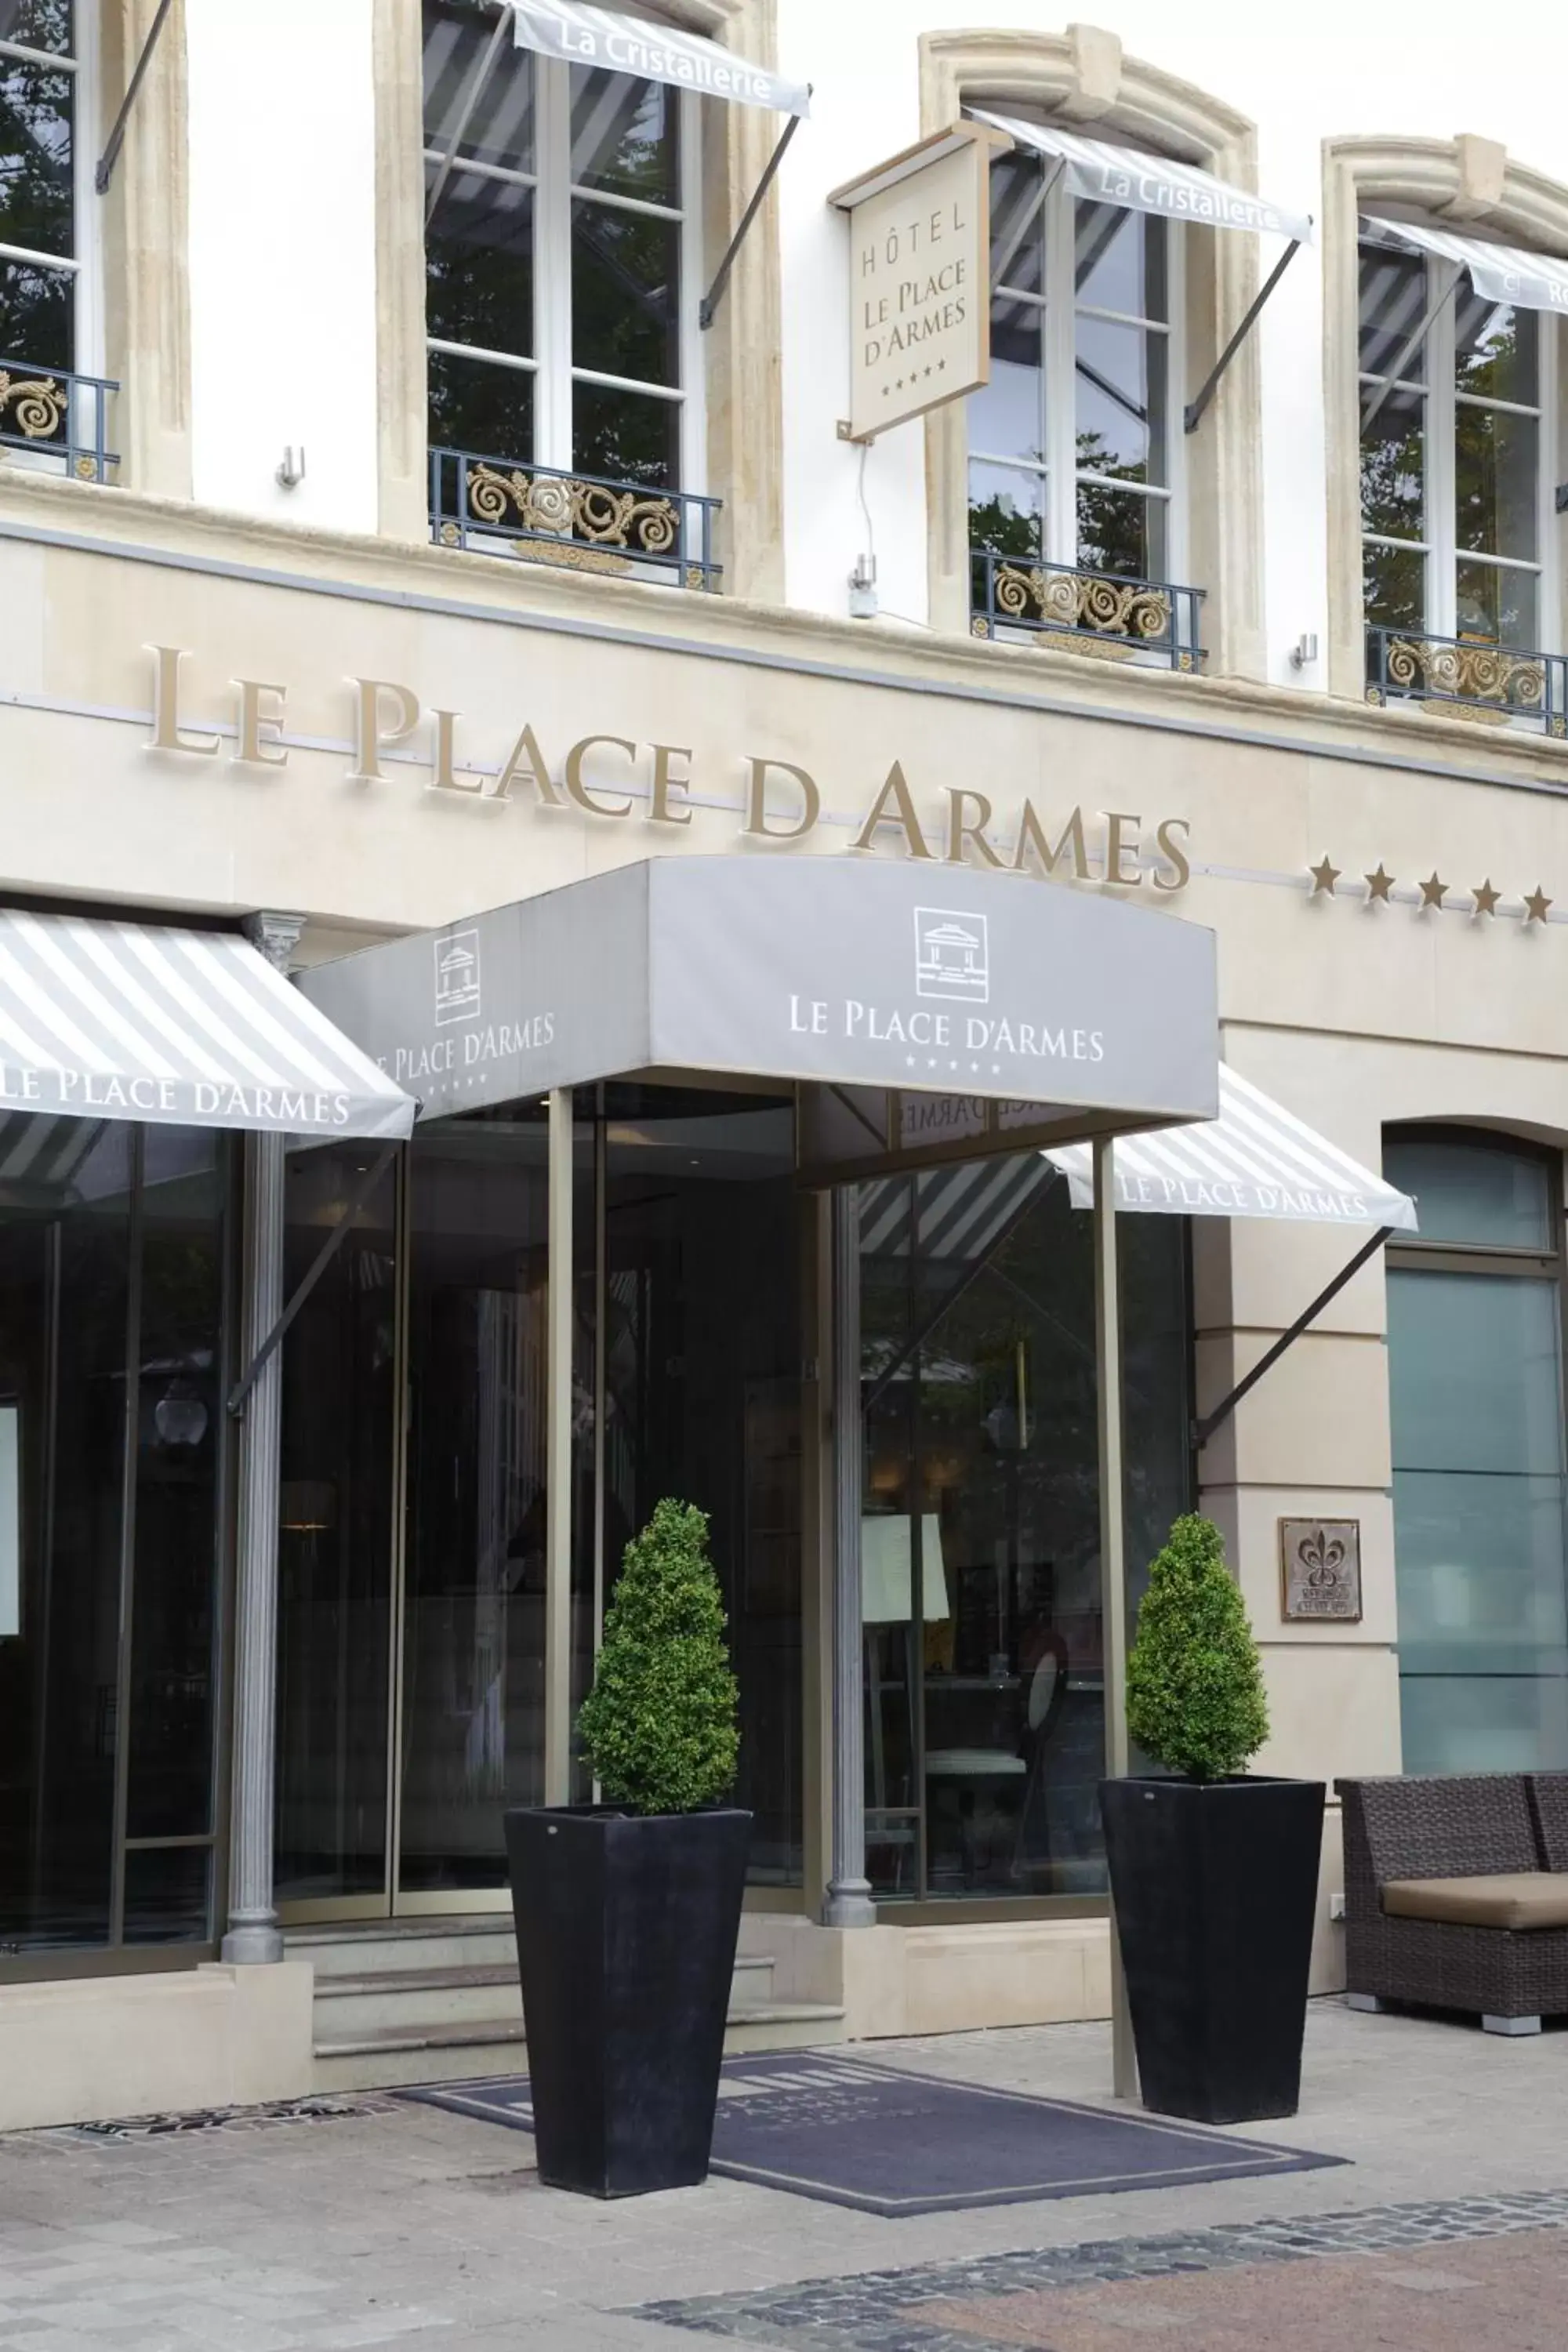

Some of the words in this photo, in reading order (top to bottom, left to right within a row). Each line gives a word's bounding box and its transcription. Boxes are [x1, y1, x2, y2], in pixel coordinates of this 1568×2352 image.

[560, 20, 596, 56] La
[605, 32, 771, 99] Cristallerie
[1101, 167, 1131, 198] La
[1139, 176, 1281, 229] Cristallerie
[862, 202, 966, 278] HÔTEL
[865, 301, 888, 330] LE
[898, 259, 966, 314] PLACE
[864, 297, 967, 368] D'ARMES
[143, 644, 289, 766] LE
[343, 677, 693, 825] PLACE
[395, 1039, 455, 1081] PLACE
[464, 1012, 555, 1065] D'ARMES
[789, 994, 829, 1035] LE
[844, 1000, 950, 1047] PLACE
[966, 1017, 1105, 1062] D'ARMES
[0, 1064, 41, 1099] LE
[59, 1067, 177, 1111] PLACE
[194, 1082, 350, 1124] D'ARMES
[1121, 1176, 1152, 1203] LE
[1161, 1177, 1250, 1209] PLACE
[1255, 1185, 1368, 1217] D'ARMES
